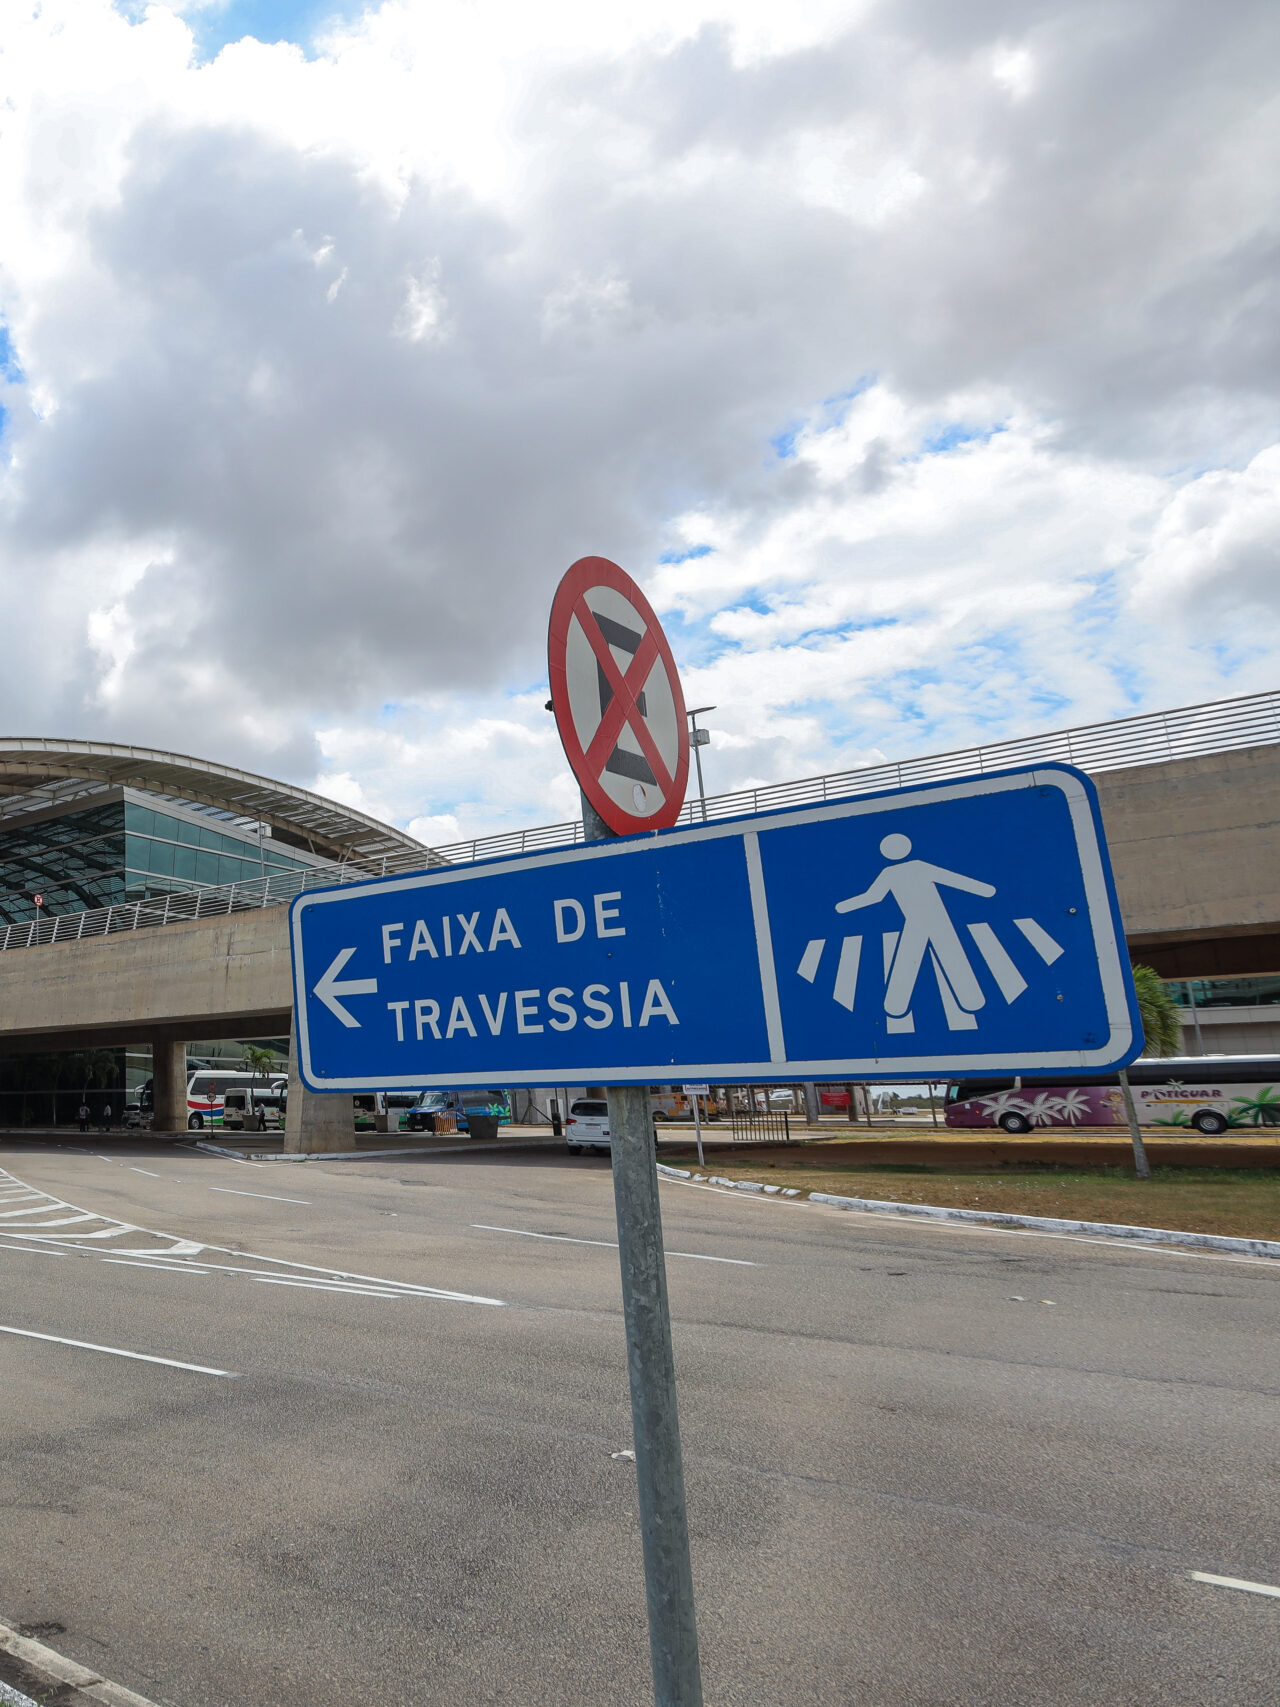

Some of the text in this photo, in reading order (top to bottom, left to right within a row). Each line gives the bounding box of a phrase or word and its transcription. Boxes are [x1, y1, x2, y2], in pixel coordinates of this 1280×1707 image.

[381, 891, 626, 964] FAIXA DE
[387, 979, 680, 1042] TRAVESSIA
